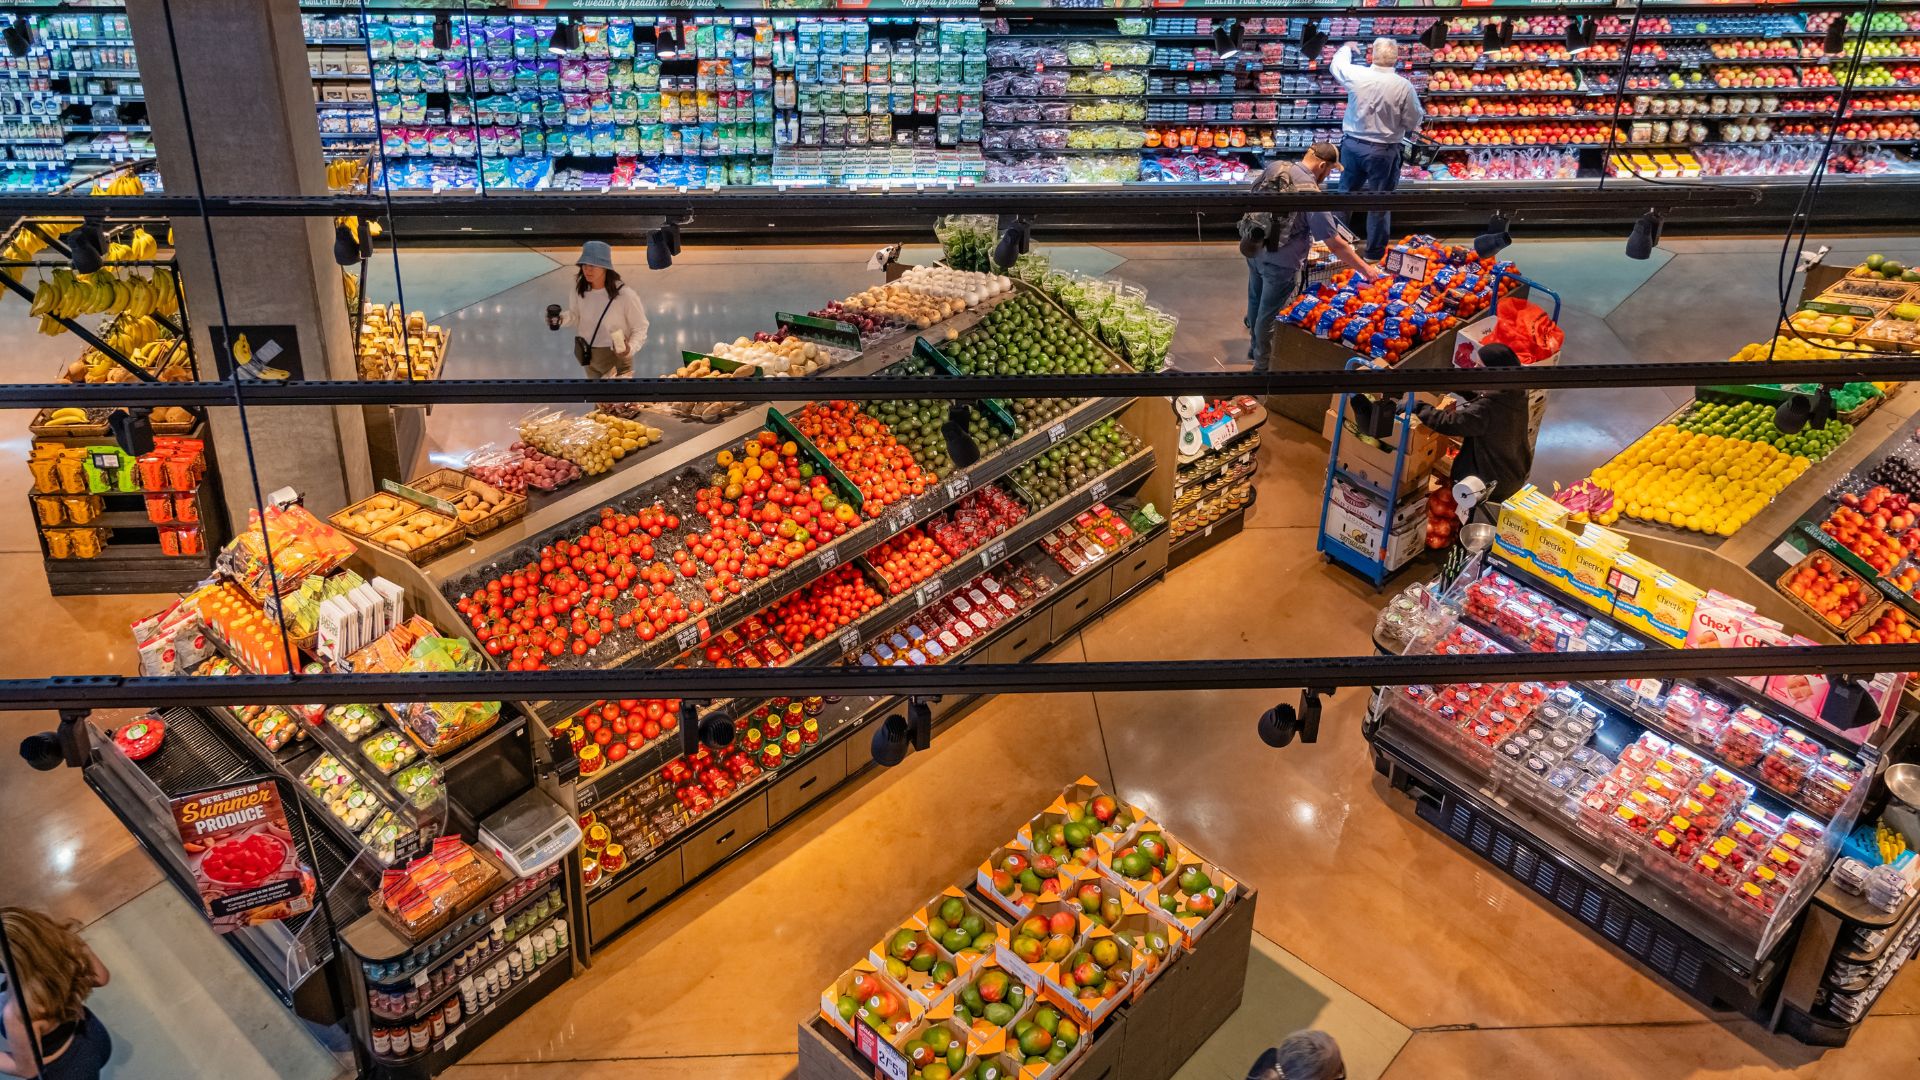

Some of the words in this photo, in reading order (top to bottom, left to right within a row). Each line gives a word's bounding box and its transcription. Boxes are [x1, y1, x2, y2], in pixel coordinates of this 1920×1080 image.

[670, 0, 695, 9] every
[1503, 516, 1529, 535] Cheerios
[1539, 535, 1566, 554] Cheerios
[1804, 526, 1833, 548] ORGANIC
[1576, 554, 1604, 574] Cheerios
[1656, 594, 1687, 614] Cheerios
[1699, 613, 1731, 634] Chex
[200, 793, 223, 806] WE'RE
[223, 787, 247, 801] SWEET
[247, 784, 259, 795] ON
[182, 789, 272, 823] Summer
[195, 804, 266, 835] PRODUCE
